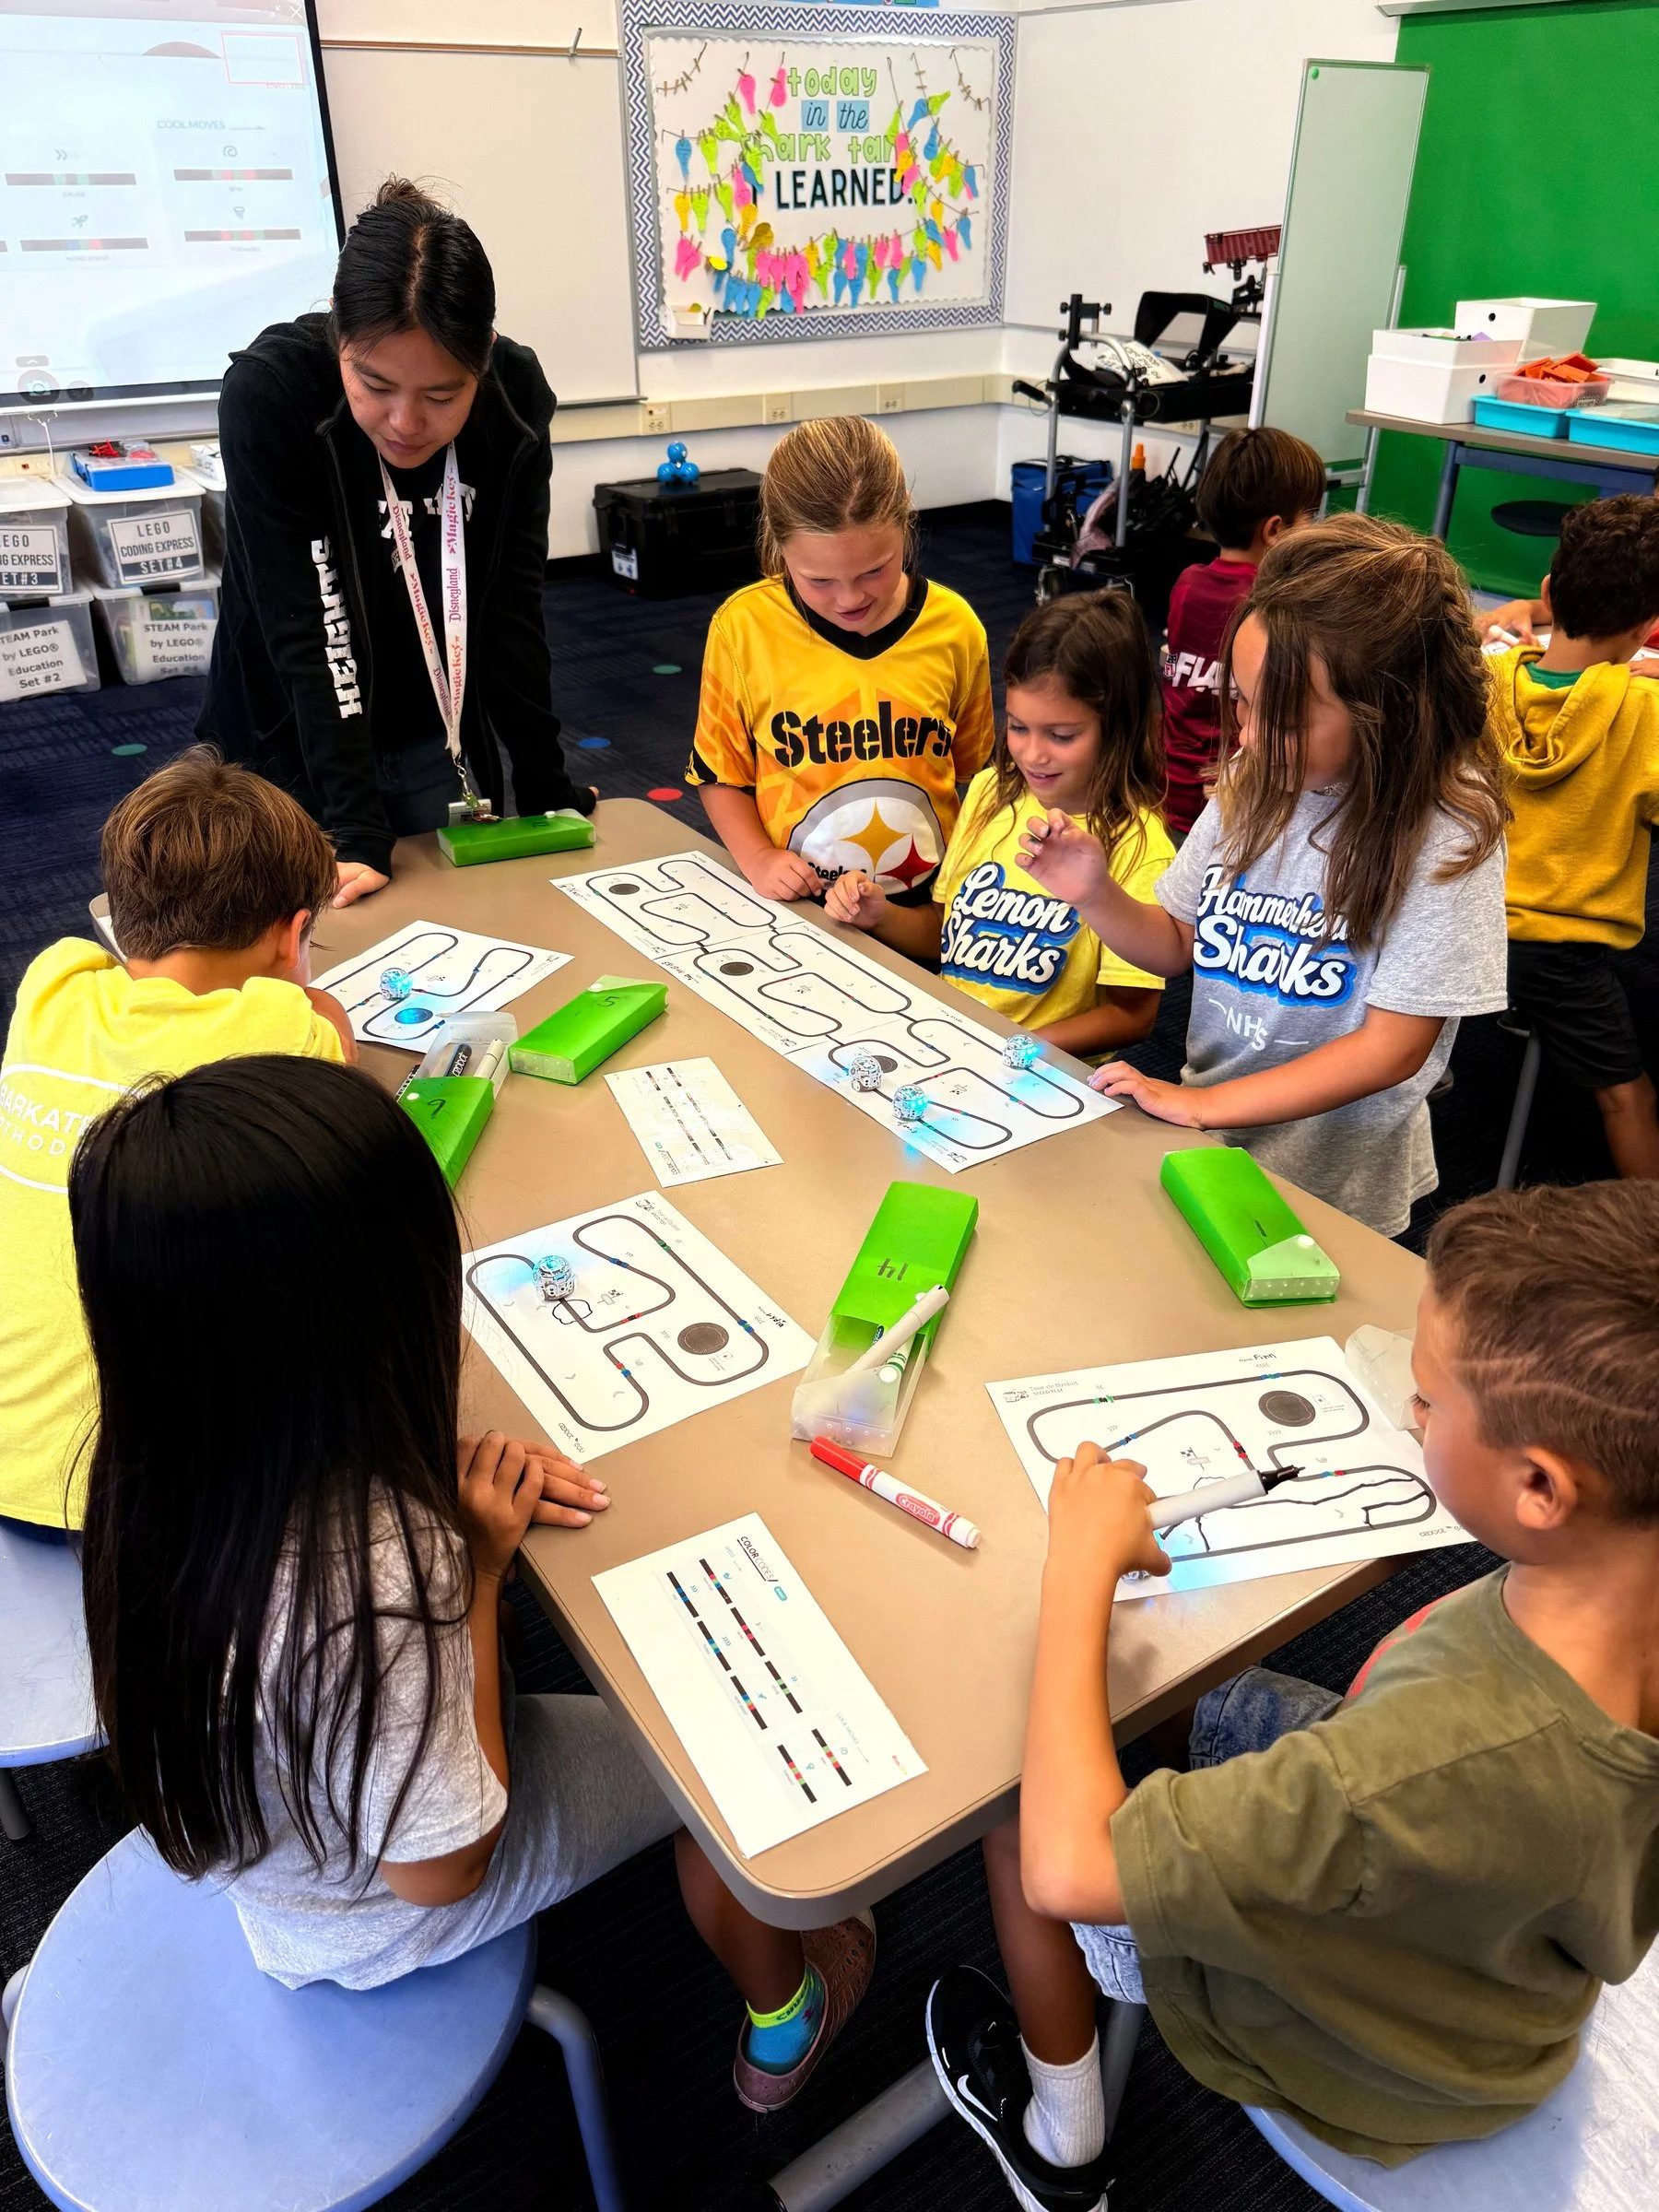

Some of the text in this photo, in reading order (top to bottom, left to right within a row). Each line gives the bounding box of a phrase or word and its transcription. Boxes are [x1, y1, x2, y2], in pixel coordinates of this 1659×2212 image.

[787, 66, 877, 97] today
[806, 102, 869, 131] in the
[136, 522, 171, 537] LEGO
[121, 537, 194, 558] CODING EXPRESS
[11, 554, 54, 566] EXPRESS
[2, 573, 39, 585] ET#3
[448, 568, 462, 623] Disneyland
[1, 626, 60, 645] TEAM Park
[144, 622, 208, 632] STEAM Park
[150, 640, 163, 649] by
[3, 653, 16, 662] by
[153, 653, 206, 663] Education
[8, 659, 64, 677] Education
[19, 673, 62, 689] Set #2
[771, 701, 952, 768] Steelers
[953, 863, 1074, 934] Lemon
[941, 916, 1061, 982] Sharks
[1194, 915, 1353, 998] Sharks
[596, 995, 620, 1007] 5
[899, 1496, 935, 1523] Crayola
[740, 1535, 774, 1579] COLOR CODES
